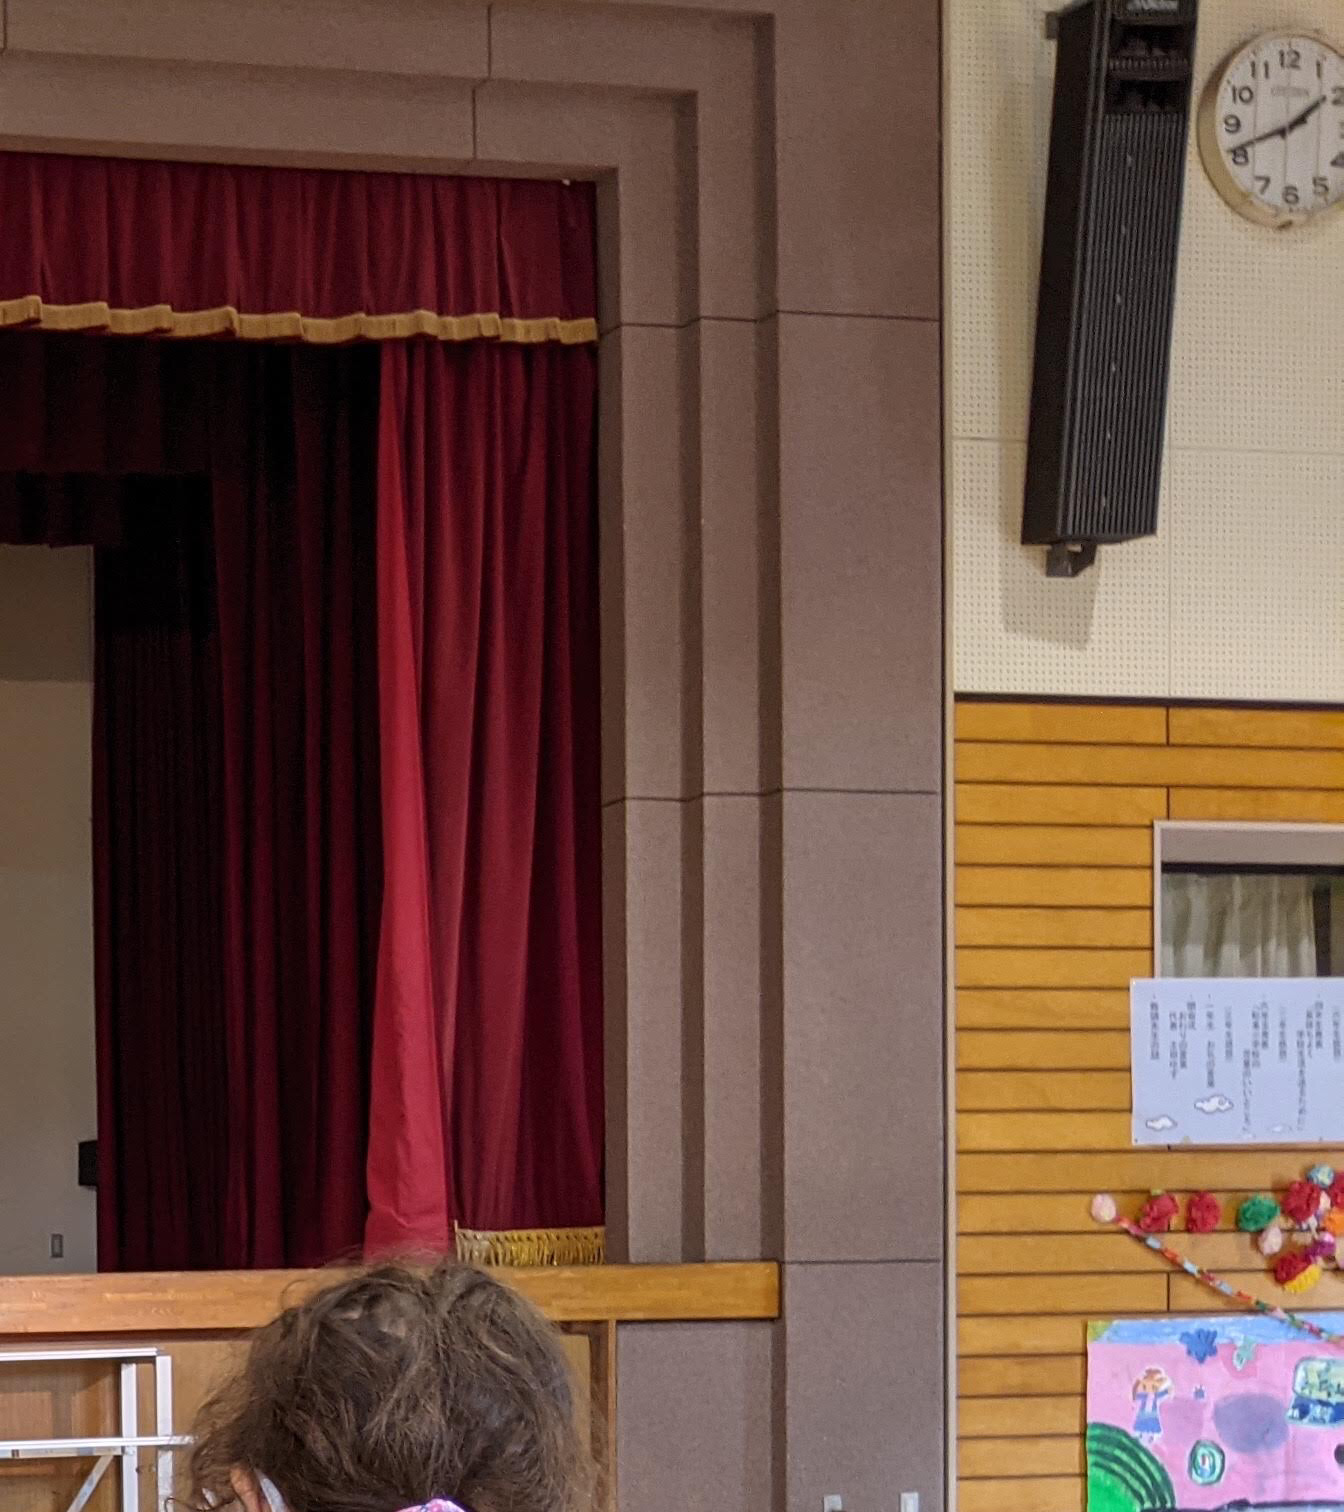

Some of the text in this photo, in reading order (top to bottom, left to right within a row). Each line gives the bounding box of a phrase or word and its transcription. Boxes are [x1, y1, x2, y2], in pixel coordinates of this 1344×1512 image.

[1279, 49, 1301, 69] 12
[1250, 60, 1269, 79] 11
[1315, 60, 1322, 79] 1
[1231, 85, 1254, 105] 10
[1331, 86, 1344, 106] 2
[1223, 114, 1242, 134] 9
[1231, 147, 1249, 166] 8
[1253, 175, 1271, 195] 7
[1312, 176, 1329, 195] 5
[1282, 185, 1300, 206] 6
